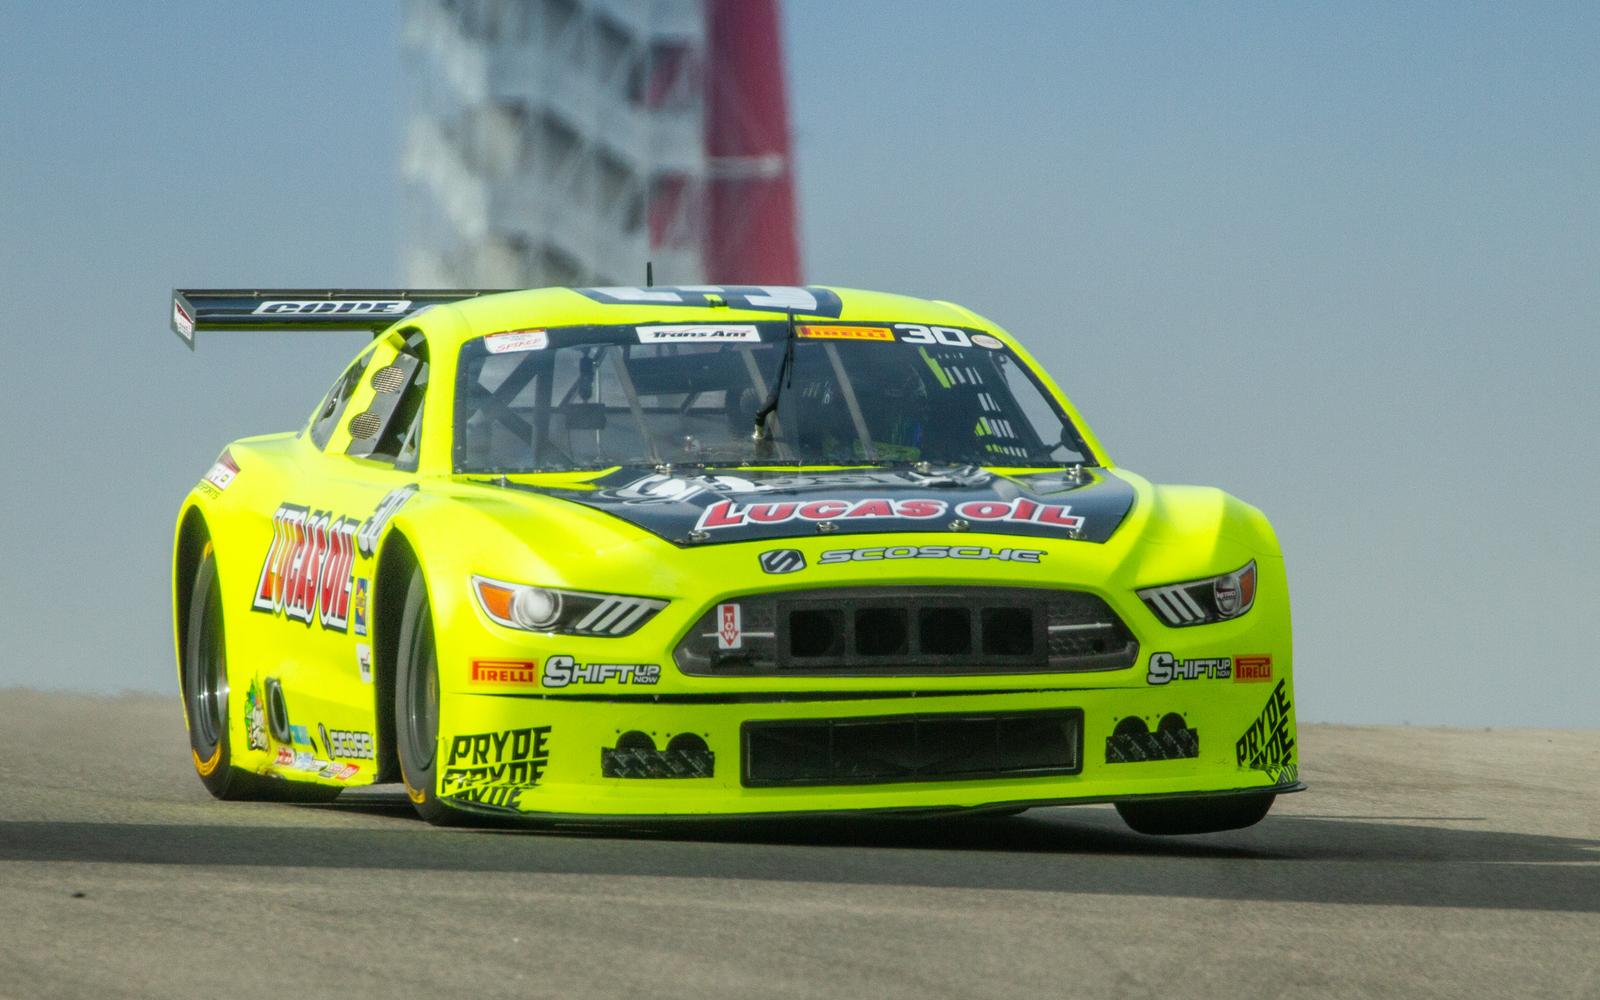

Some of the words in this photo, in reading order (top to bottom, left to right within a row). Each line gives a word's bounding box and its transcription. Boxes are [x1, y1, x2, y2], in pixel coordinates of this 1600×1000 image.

[653, 330, 707, 338] Trans
[710, 330, 748, 338] Am
[894, 324, 972, 347] 30
[695, 498, 948, 530] LUCAS
[817, 546, 1043, 564] SCOSCHE
[724, 612, 736, 640] TOW
[472, 661, 534, 682] PIRELLI
[542, 655, 636, 687] SHIFT
[634, 664, 661, 676] UP
[633, 676, 660, 685] NOW
[1147, 652, 1217, 685] SHIFT
[1216, 658, 1231, 670] UP
[1235, 657, 1271, 679] PIRELLI
[1236, 678, 1291, 768] PRYDE
[447, 726, 552, 766] PRYDE
